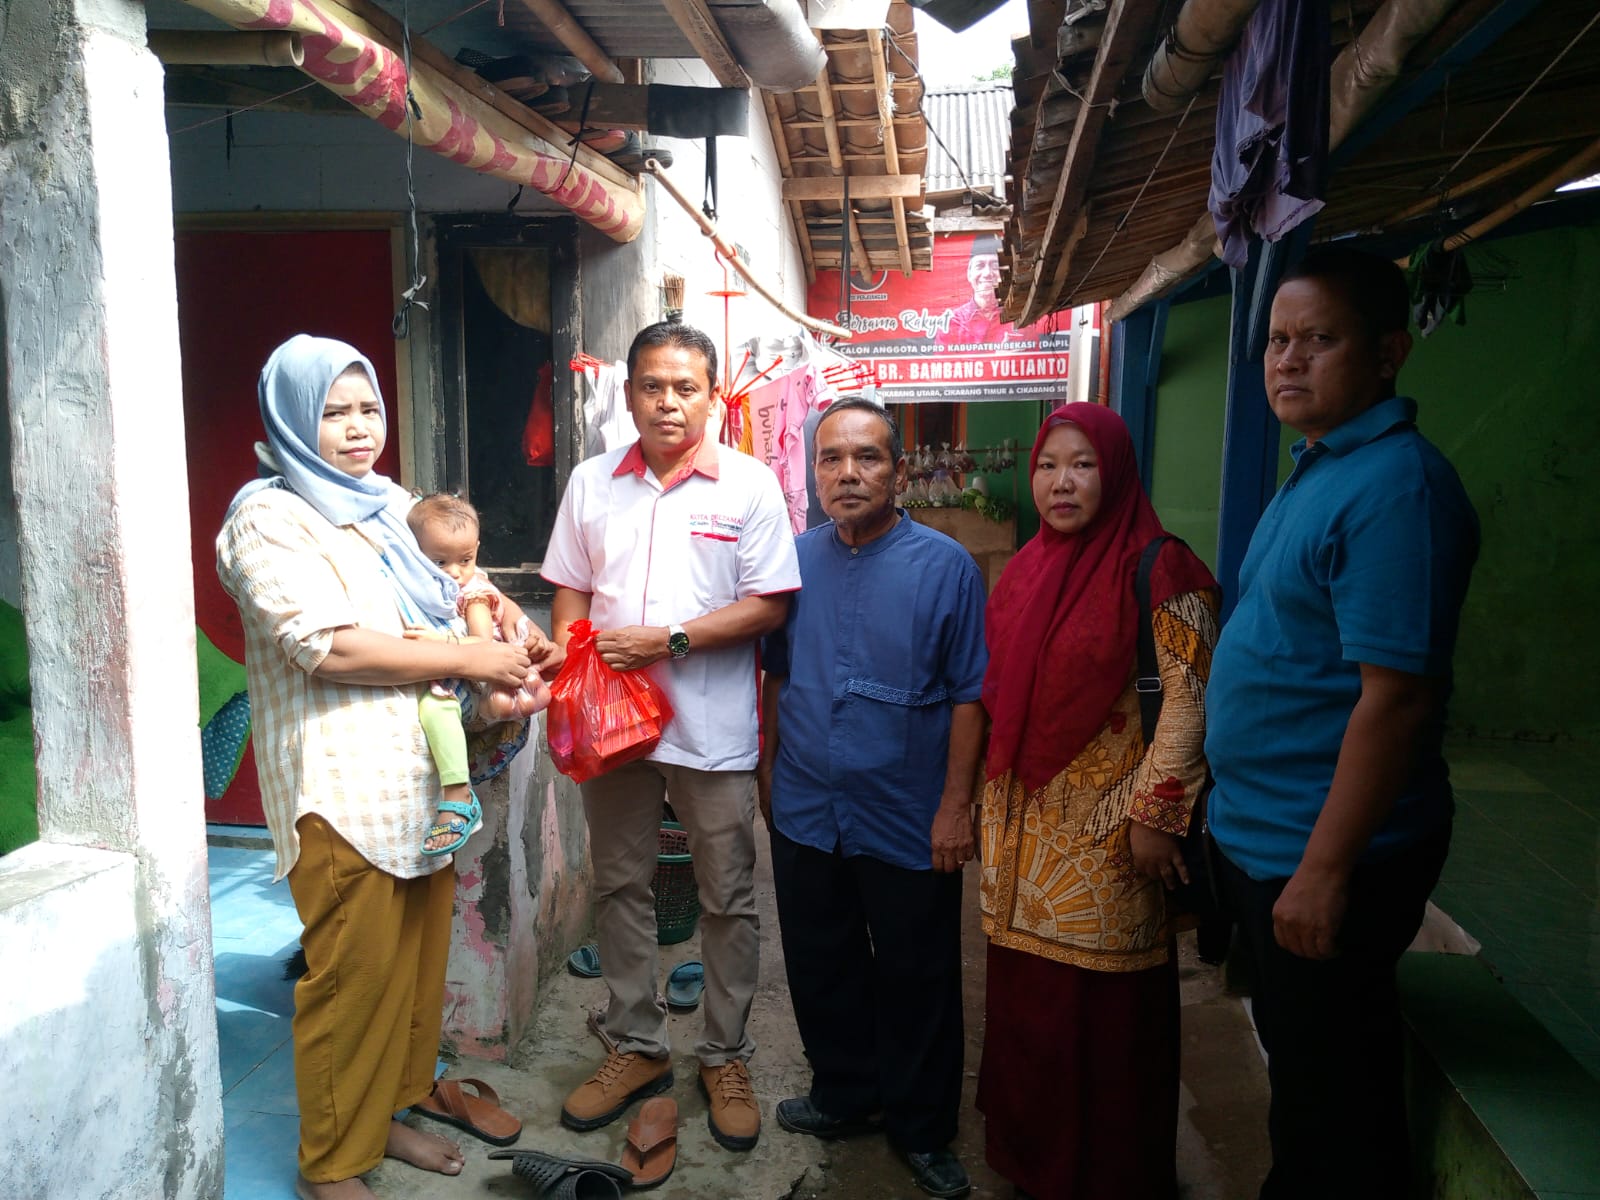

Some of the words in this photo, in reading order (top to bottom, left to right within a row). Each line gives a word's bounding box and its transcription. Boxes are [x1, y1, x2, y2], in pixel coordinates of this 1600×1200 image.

[899, 308, 953, 338] Rakyat
[840, 345, 870, 355] CALON
[873, 344, 918, 354] ANGGOTA
[920, 343, 945, 353] DPRD
[947, 342, 1001, 352] KABUPATEN
[1003, 340, 1036, 350] BEKASI
[1039, 339, 1070, 349] (DAPIL
[878, 362, 904, 380] BR.
[909, 360, 984, 380] BAMBANG
[990, 357, 1067, 378] YULIANTO
[916, 389, 943, 398] UTARA,
[943, 388, 982, 396] CIKARANG
[984, 387, 1008, 395] TIMUR
[1008, 387, 1014, 395] &
[1016, 386, 1056, 395] CIKARANG
